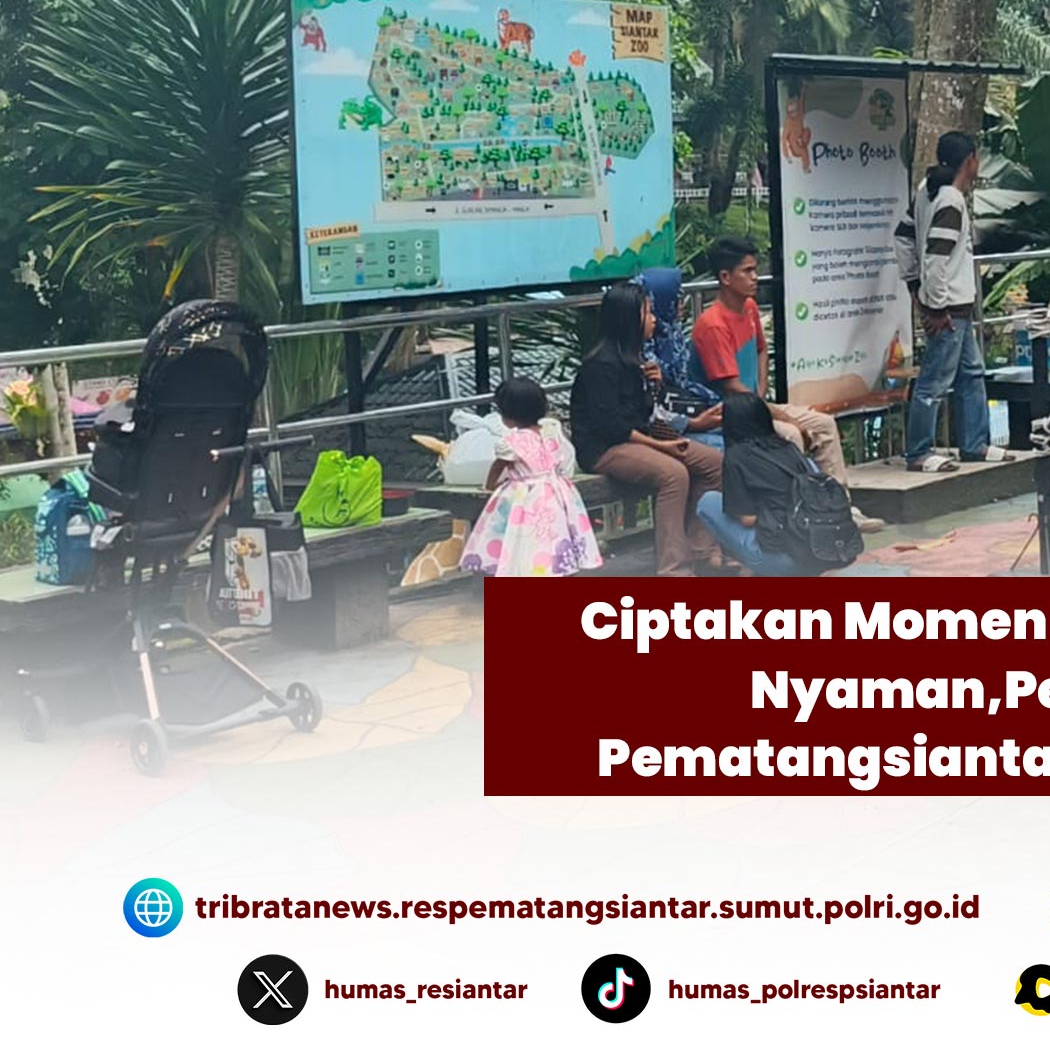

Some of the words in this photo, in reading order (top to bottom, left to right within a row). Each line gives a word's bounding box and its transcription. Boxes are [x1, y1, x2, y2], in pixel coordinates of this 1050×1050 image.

[626, 9, 653, 23] MAP
[630, 40, 649, 53] ZOO
[811, 142, 854, 166] Photo
[860, 142, 897, 166] Booth
